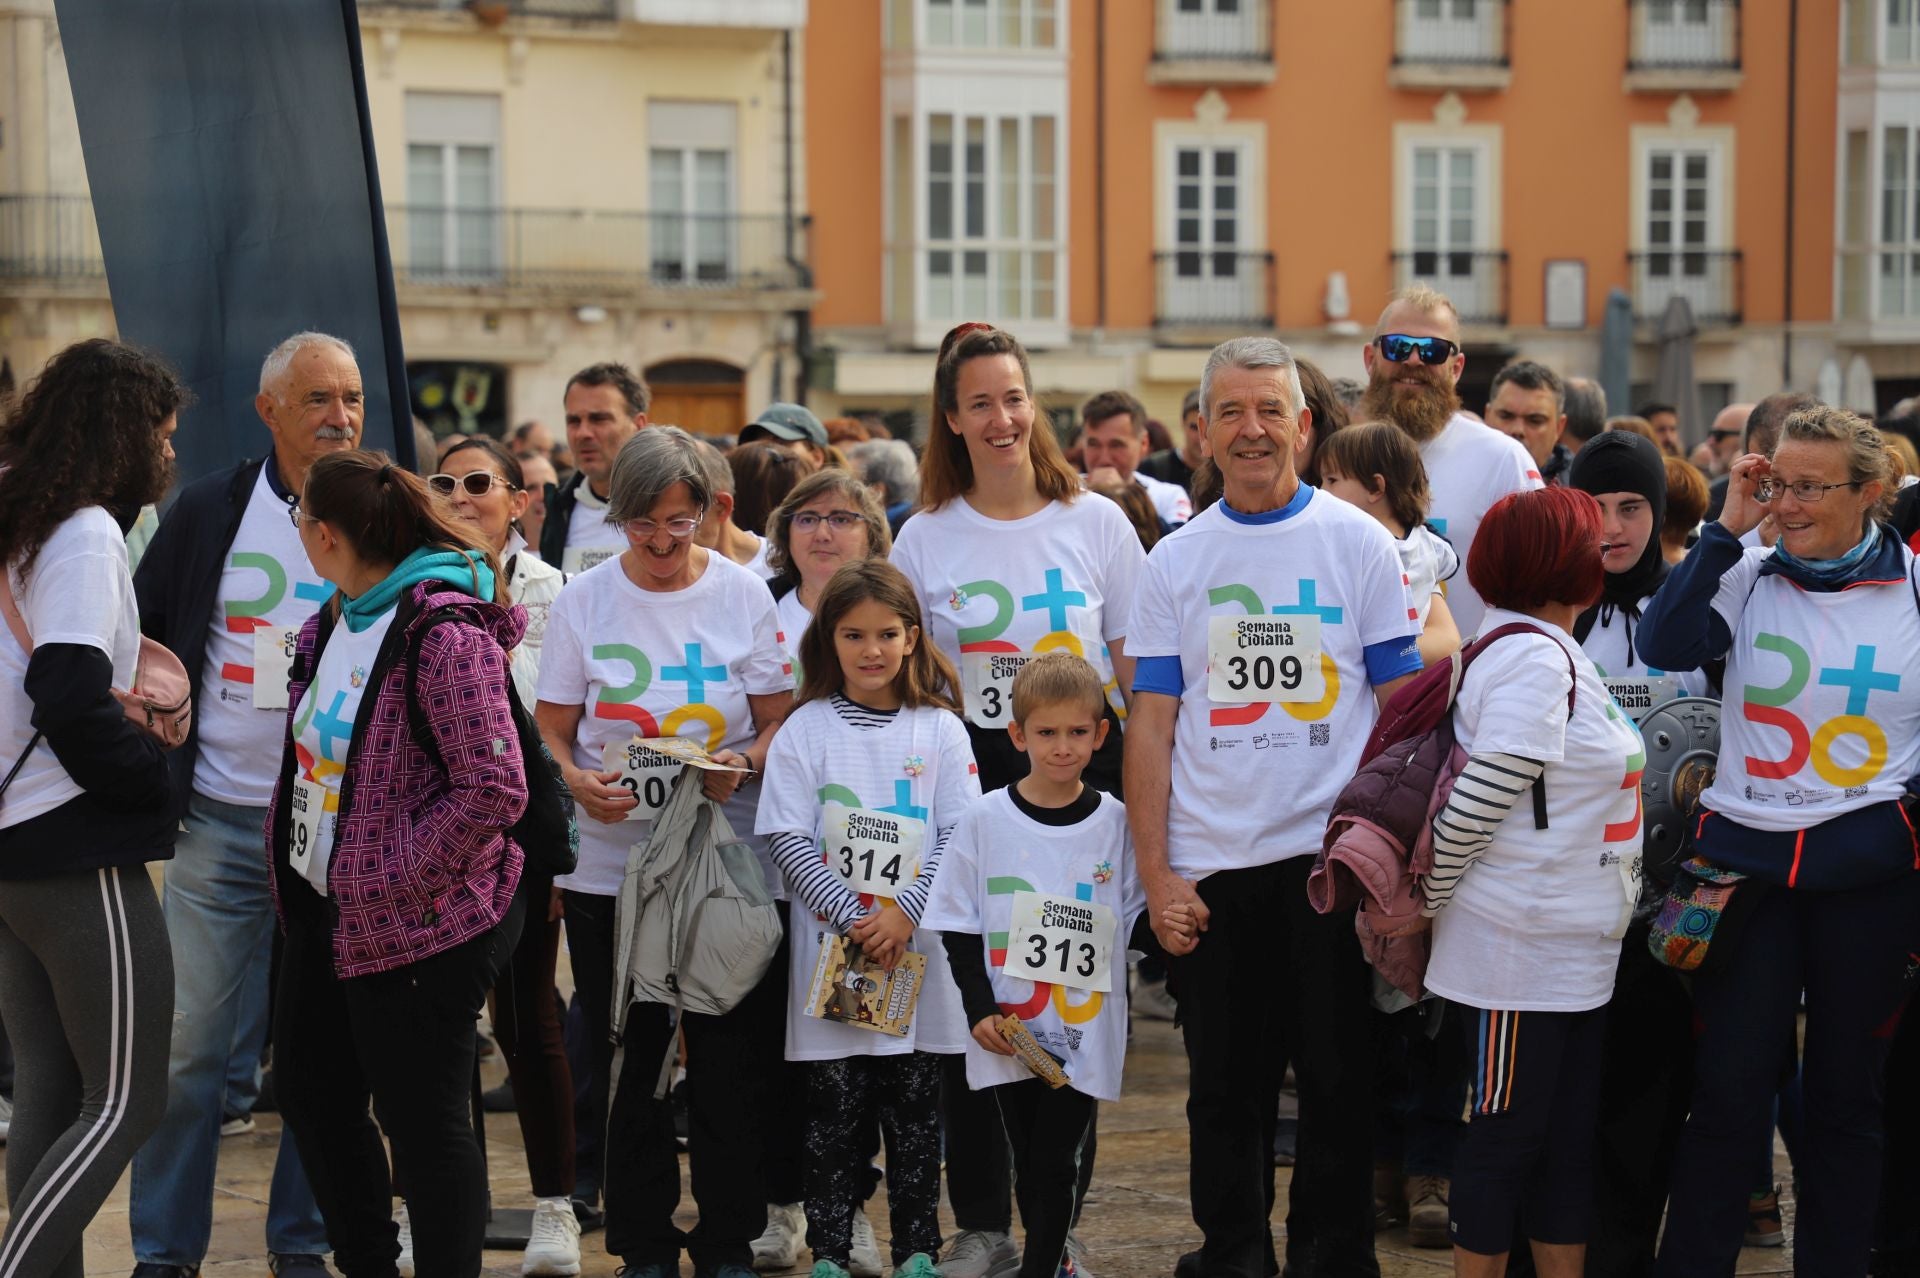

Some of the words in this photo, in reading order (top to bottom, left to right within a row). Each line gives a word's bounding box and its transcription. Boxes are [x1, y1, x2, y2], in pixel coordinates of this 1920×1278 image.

[1237, 620, 1291, 634] Semana
[1237, 633, 1294, 649] Cidiana
[990, 655, 1032, 667] Sema
[1227, 655, 1303, 691] 309
[1603, 683, 1649, 694] emana
[621, 774, 681, 808] 30
[848, 813, 898, 831] Semana
[847, 825, 899, 844] Cidiana
[839, 846, 901, 886] 314
[1043, 900, 1093, 920] Semana
[1041, 912, 1093, 934] Cidiana
[1024, 934, 1096, 978] 313
